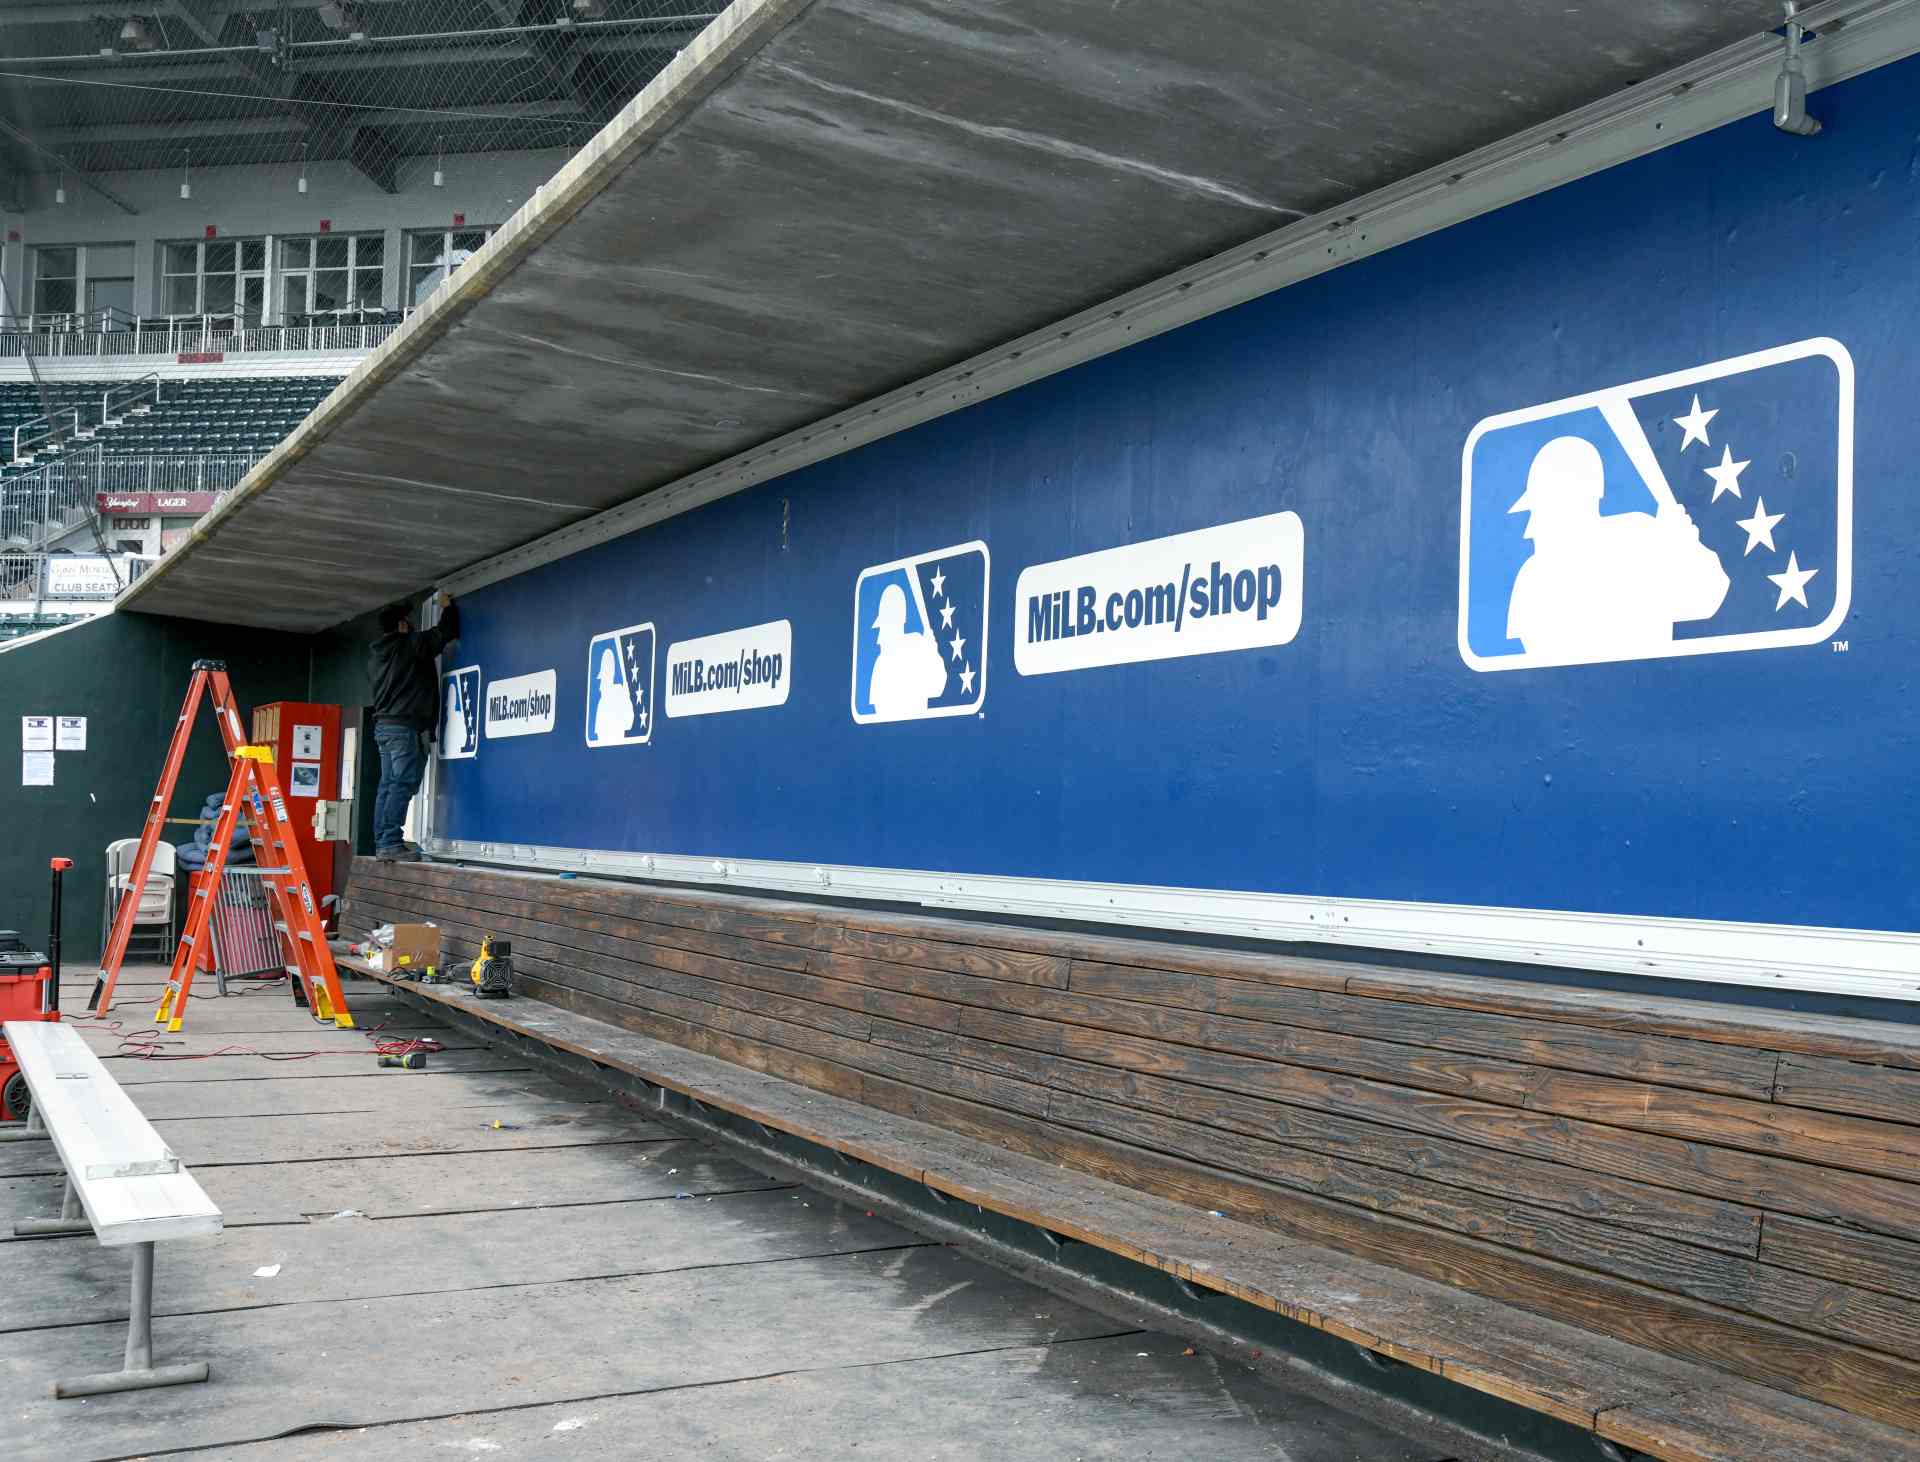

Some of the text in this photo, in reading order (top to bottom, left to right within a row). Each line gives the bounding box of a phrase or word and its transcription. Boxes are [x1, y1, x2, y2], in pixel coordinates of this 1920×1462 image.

[54, 583, 119, 592] CLUB SEATS
[1028, 561, 1282, 644] MiLB.com/shop
[1832, 641, 1849, 652] TM
[672, 648, 783, 694] MiLB.com/shop
[490, 688, 551, 723] MiLB.com/shop
